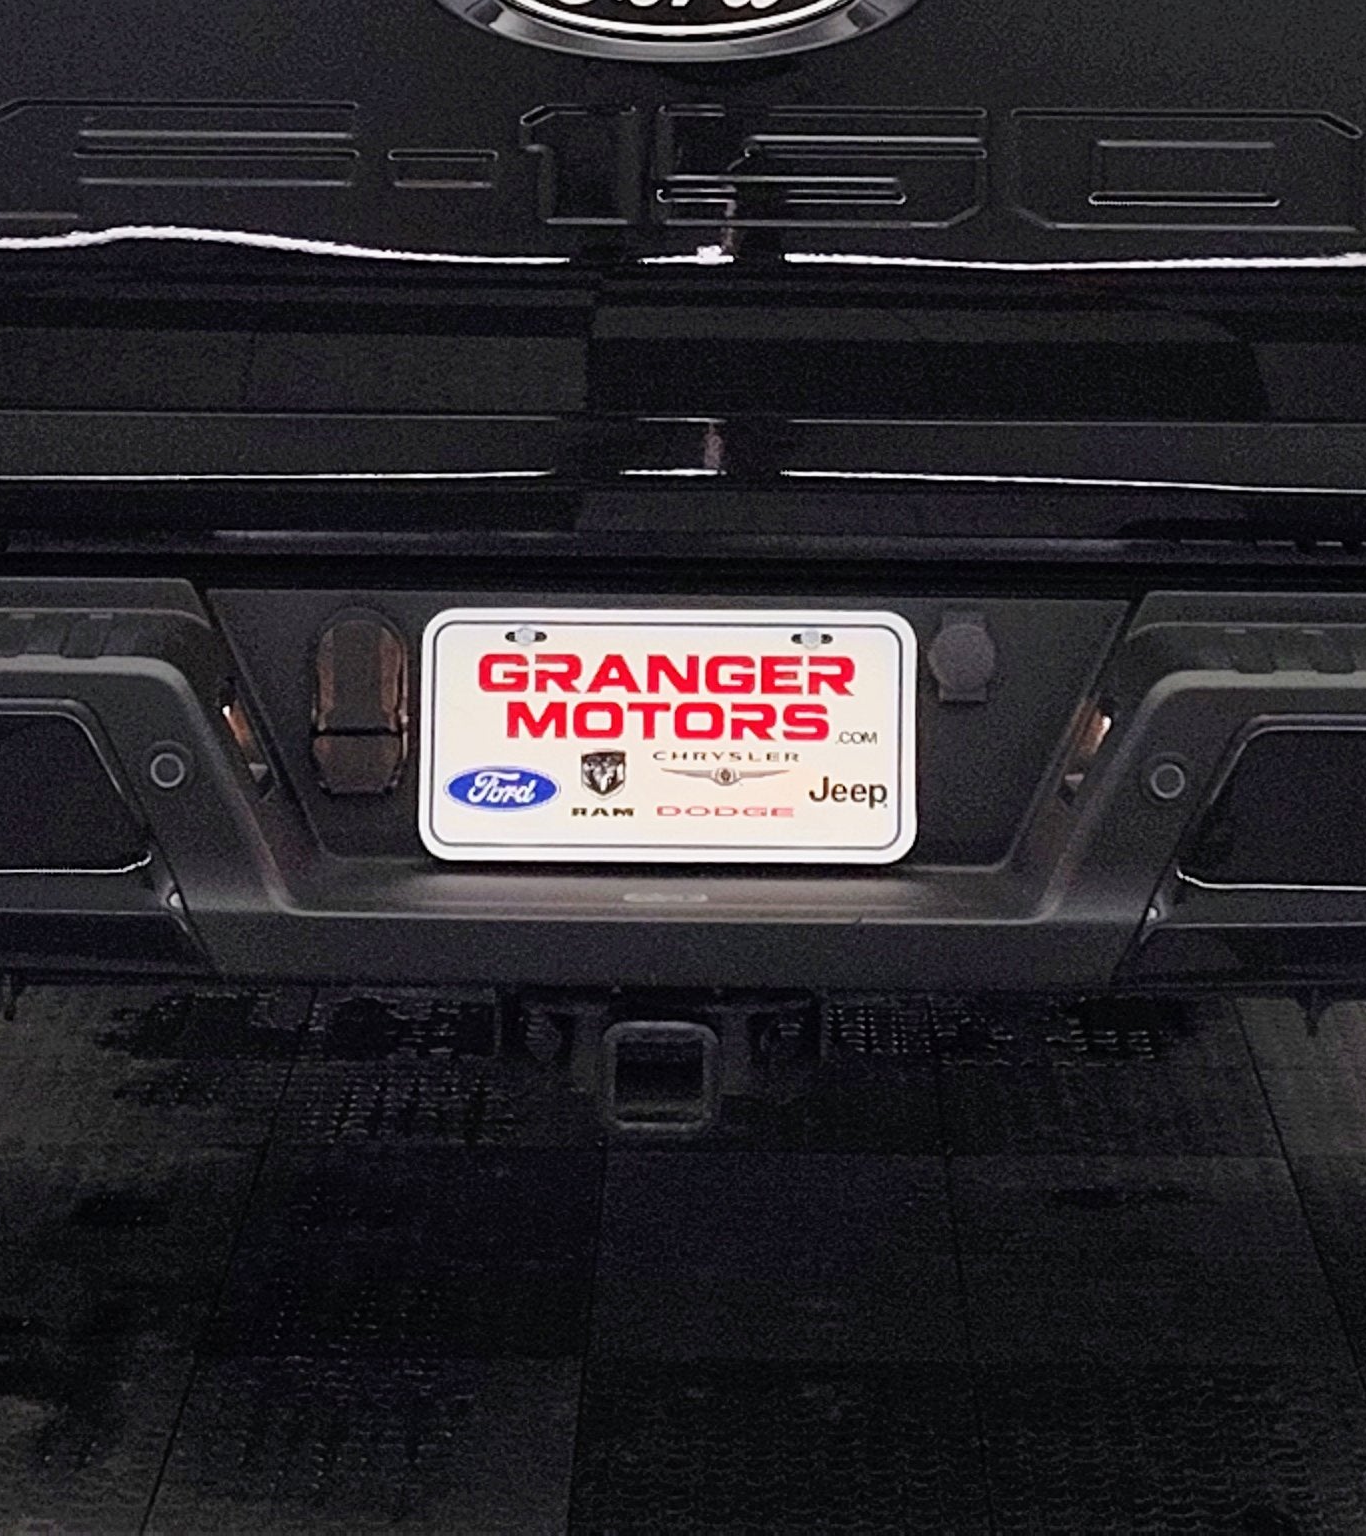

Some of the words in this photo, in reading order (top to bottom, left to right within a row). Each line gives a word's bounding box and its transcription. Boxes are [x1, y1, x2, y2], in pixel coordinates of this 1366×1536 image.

[477, 652, 856, 697] GRANGER
[506, 700, 830, 742] MOTORS
[652, 750, 800, 762] CHRYSLER
[466, 770, 538, 804] Ford
[808, 775, 888, 810] Jeep
[571, 806, 635, 817] RAM
[656, 805, 795, 817] DODGE
